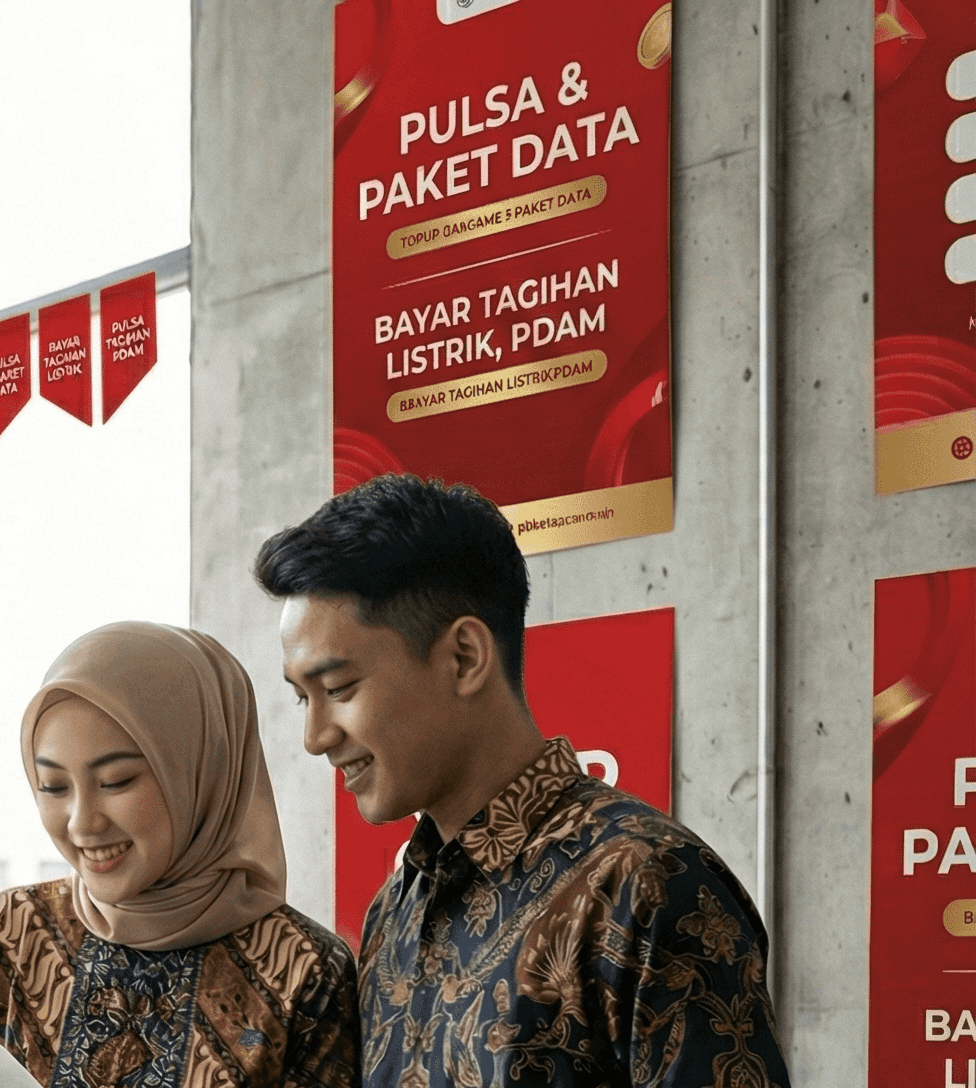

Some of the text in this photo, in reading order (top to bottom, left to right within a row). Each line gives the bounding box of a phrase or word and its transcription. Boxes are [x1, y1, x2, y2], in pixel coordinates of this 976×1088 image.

[400, 61, 589, 155] PULSA &
[359, 105, 640, 221] PAKET DATA
[400, 225, 440, 249] TOPUP
[514, 197, 554, 219] PAKET
[557, 187, 592, 207] DATA
[112, 315, 145, 334] PULSA
[375, 258, 619, 344] BAYAR TAGIHAN
[386, 303, 606, 380] LISTRIK, PDAM
[449, 377, 503, 403] TAGIHAN
